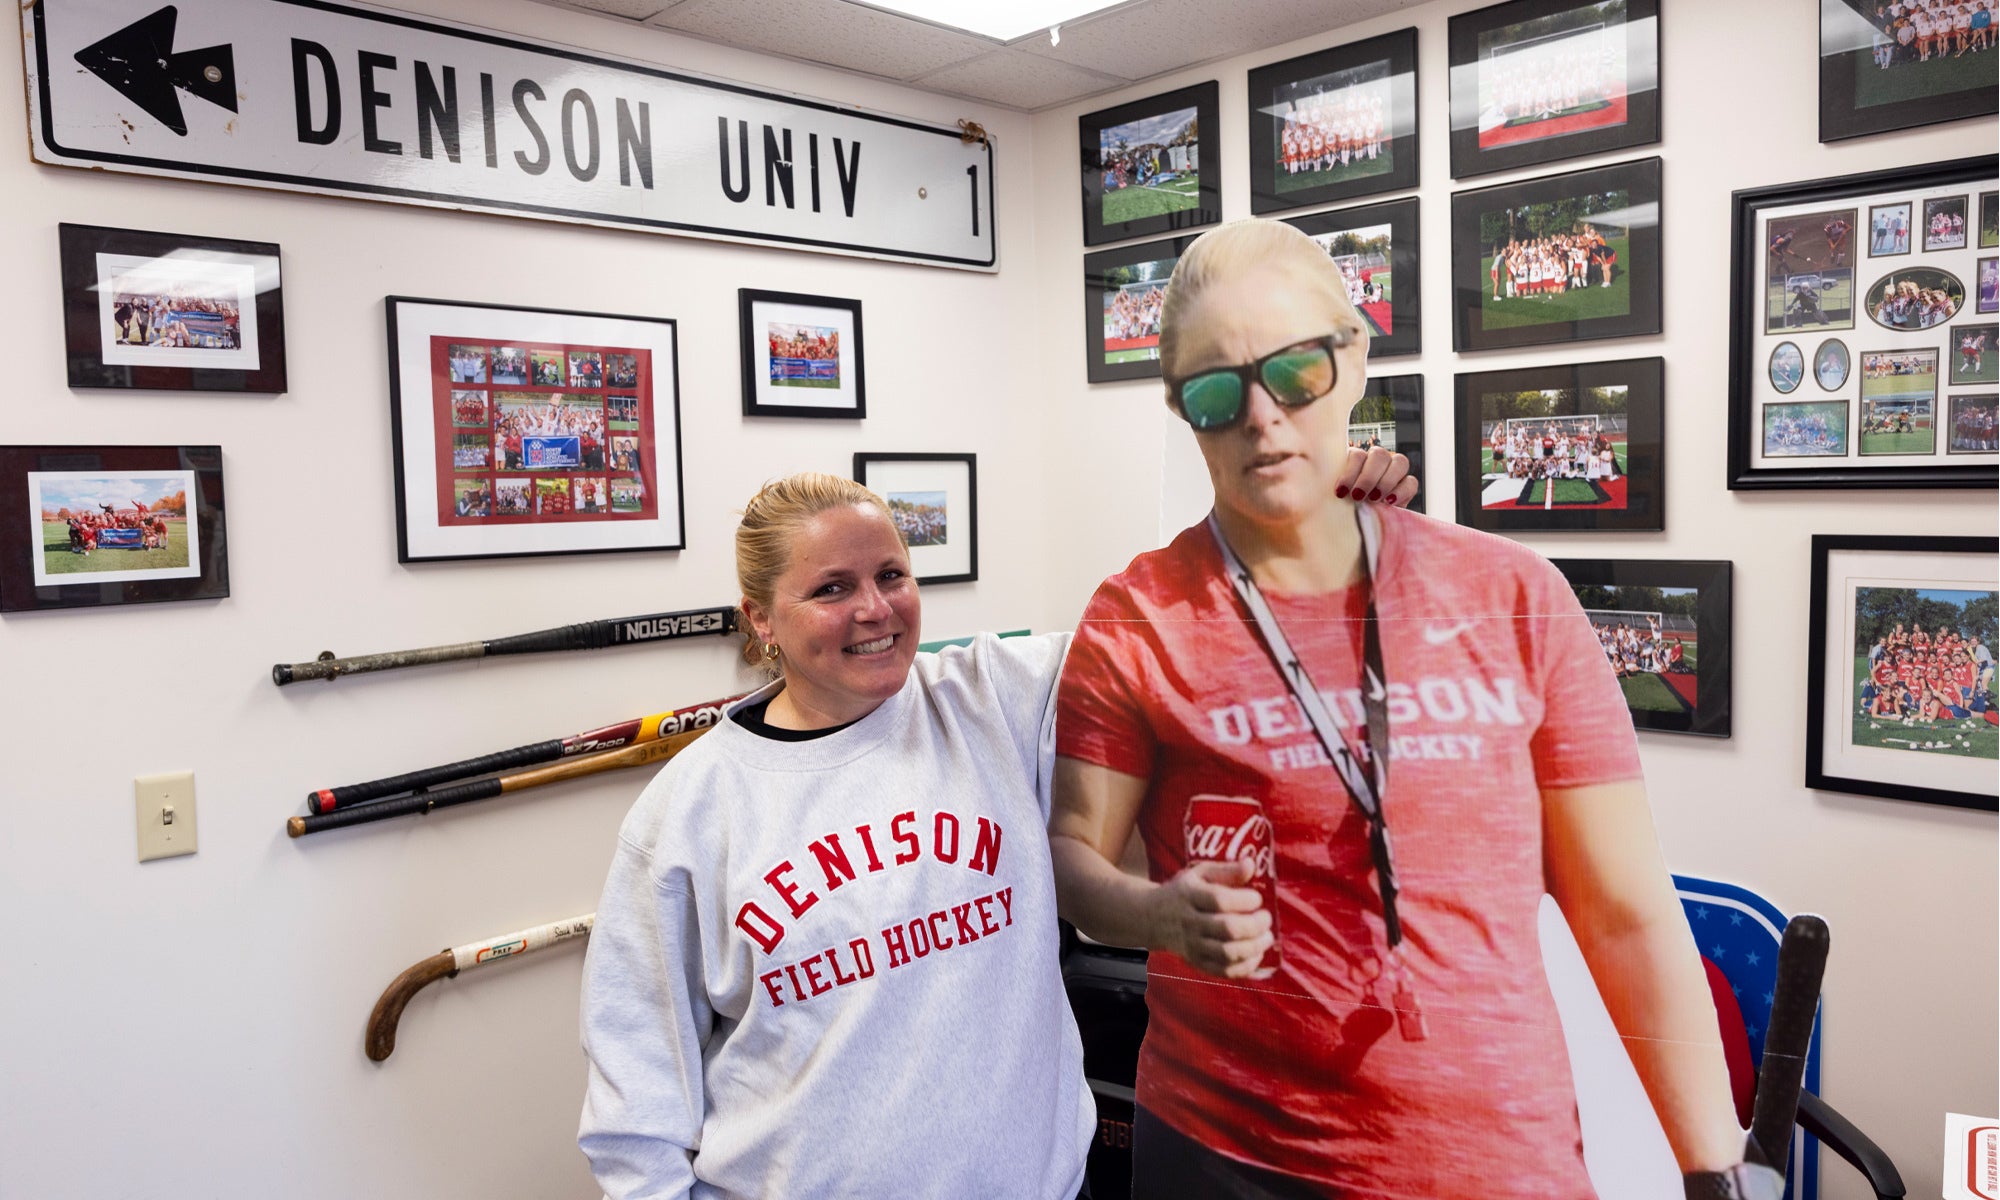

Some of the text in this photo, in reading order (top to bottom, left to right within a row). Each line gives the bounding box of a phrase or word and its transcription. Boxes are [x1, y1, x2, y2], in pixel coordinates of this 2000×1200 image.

[290, 37, 980, 237] DENISON UNIV 1
[625, 615, 691, 641] EASTON
[658, 701, 737, 738] Gray
[1268, 740, 1334, 772] FIEL
[735, 811, 1002, 956] DENISON
[760, 887, 1013, 1008] FIELD HOCKEY
